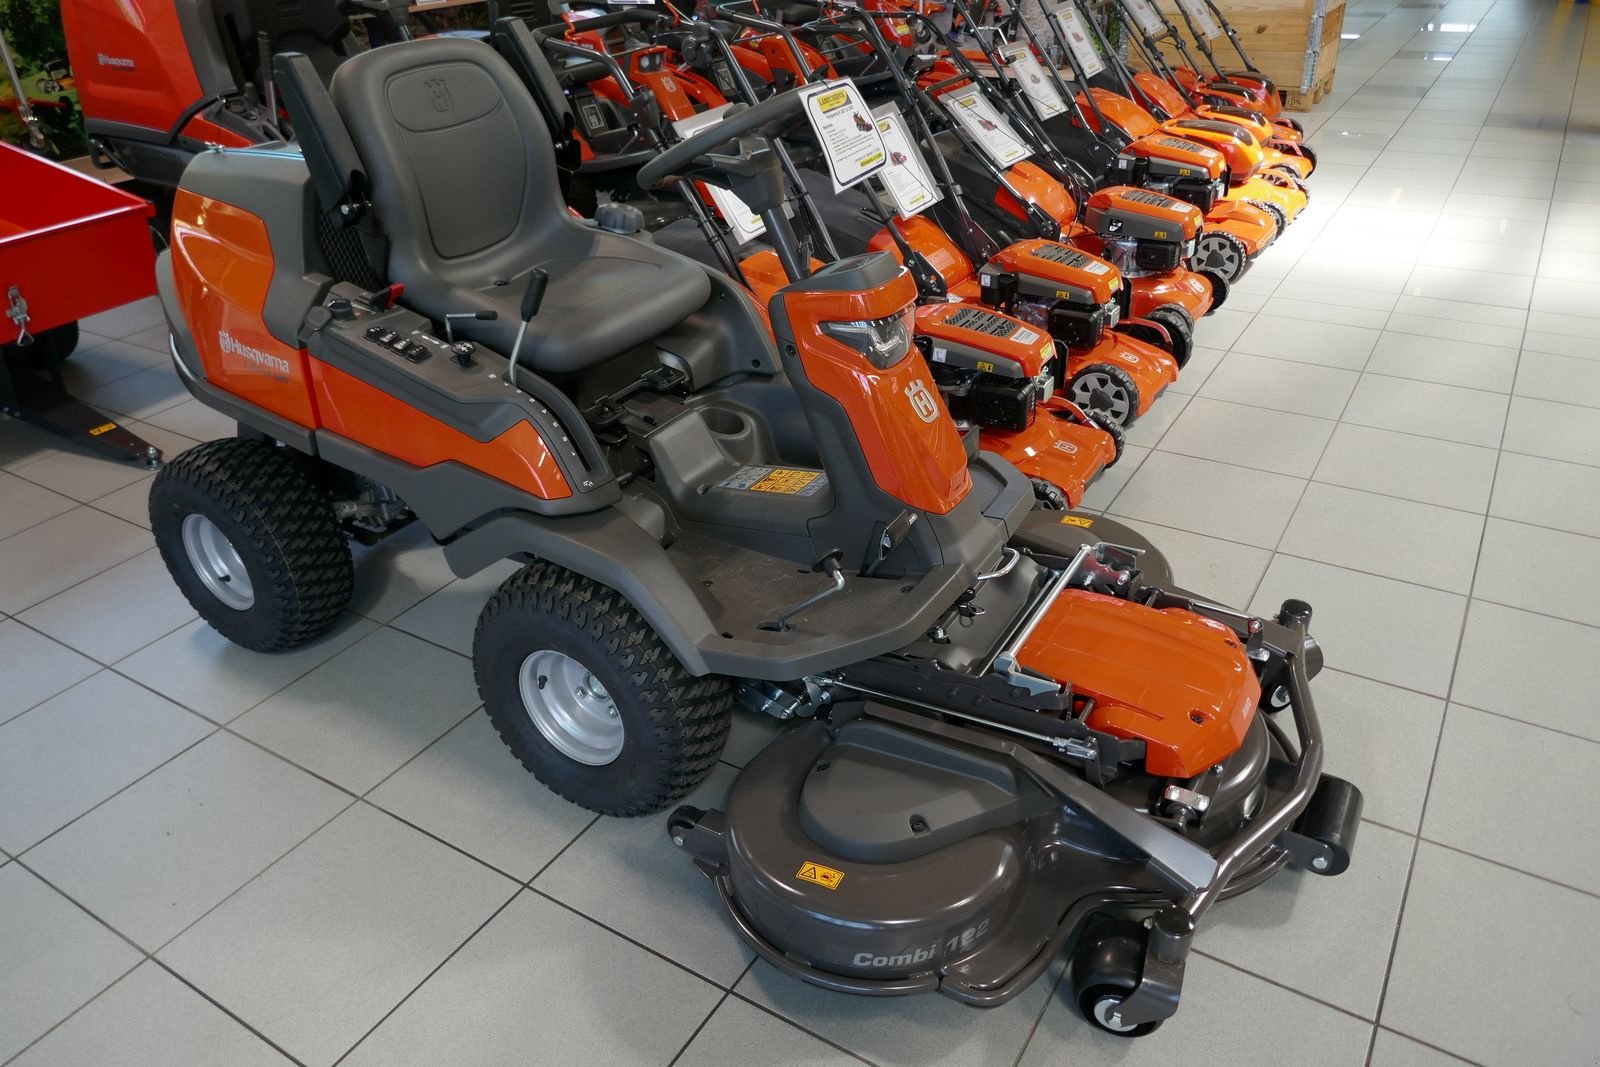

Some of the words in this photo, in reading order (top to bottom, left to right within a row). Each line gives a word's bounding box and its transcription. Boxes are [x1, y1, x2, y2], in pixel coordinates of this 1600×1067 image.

[231, 337, 289, 374] Husqvarna
[853, 944, 937, 967] Combi
[946, 917, 990, 952] 122
